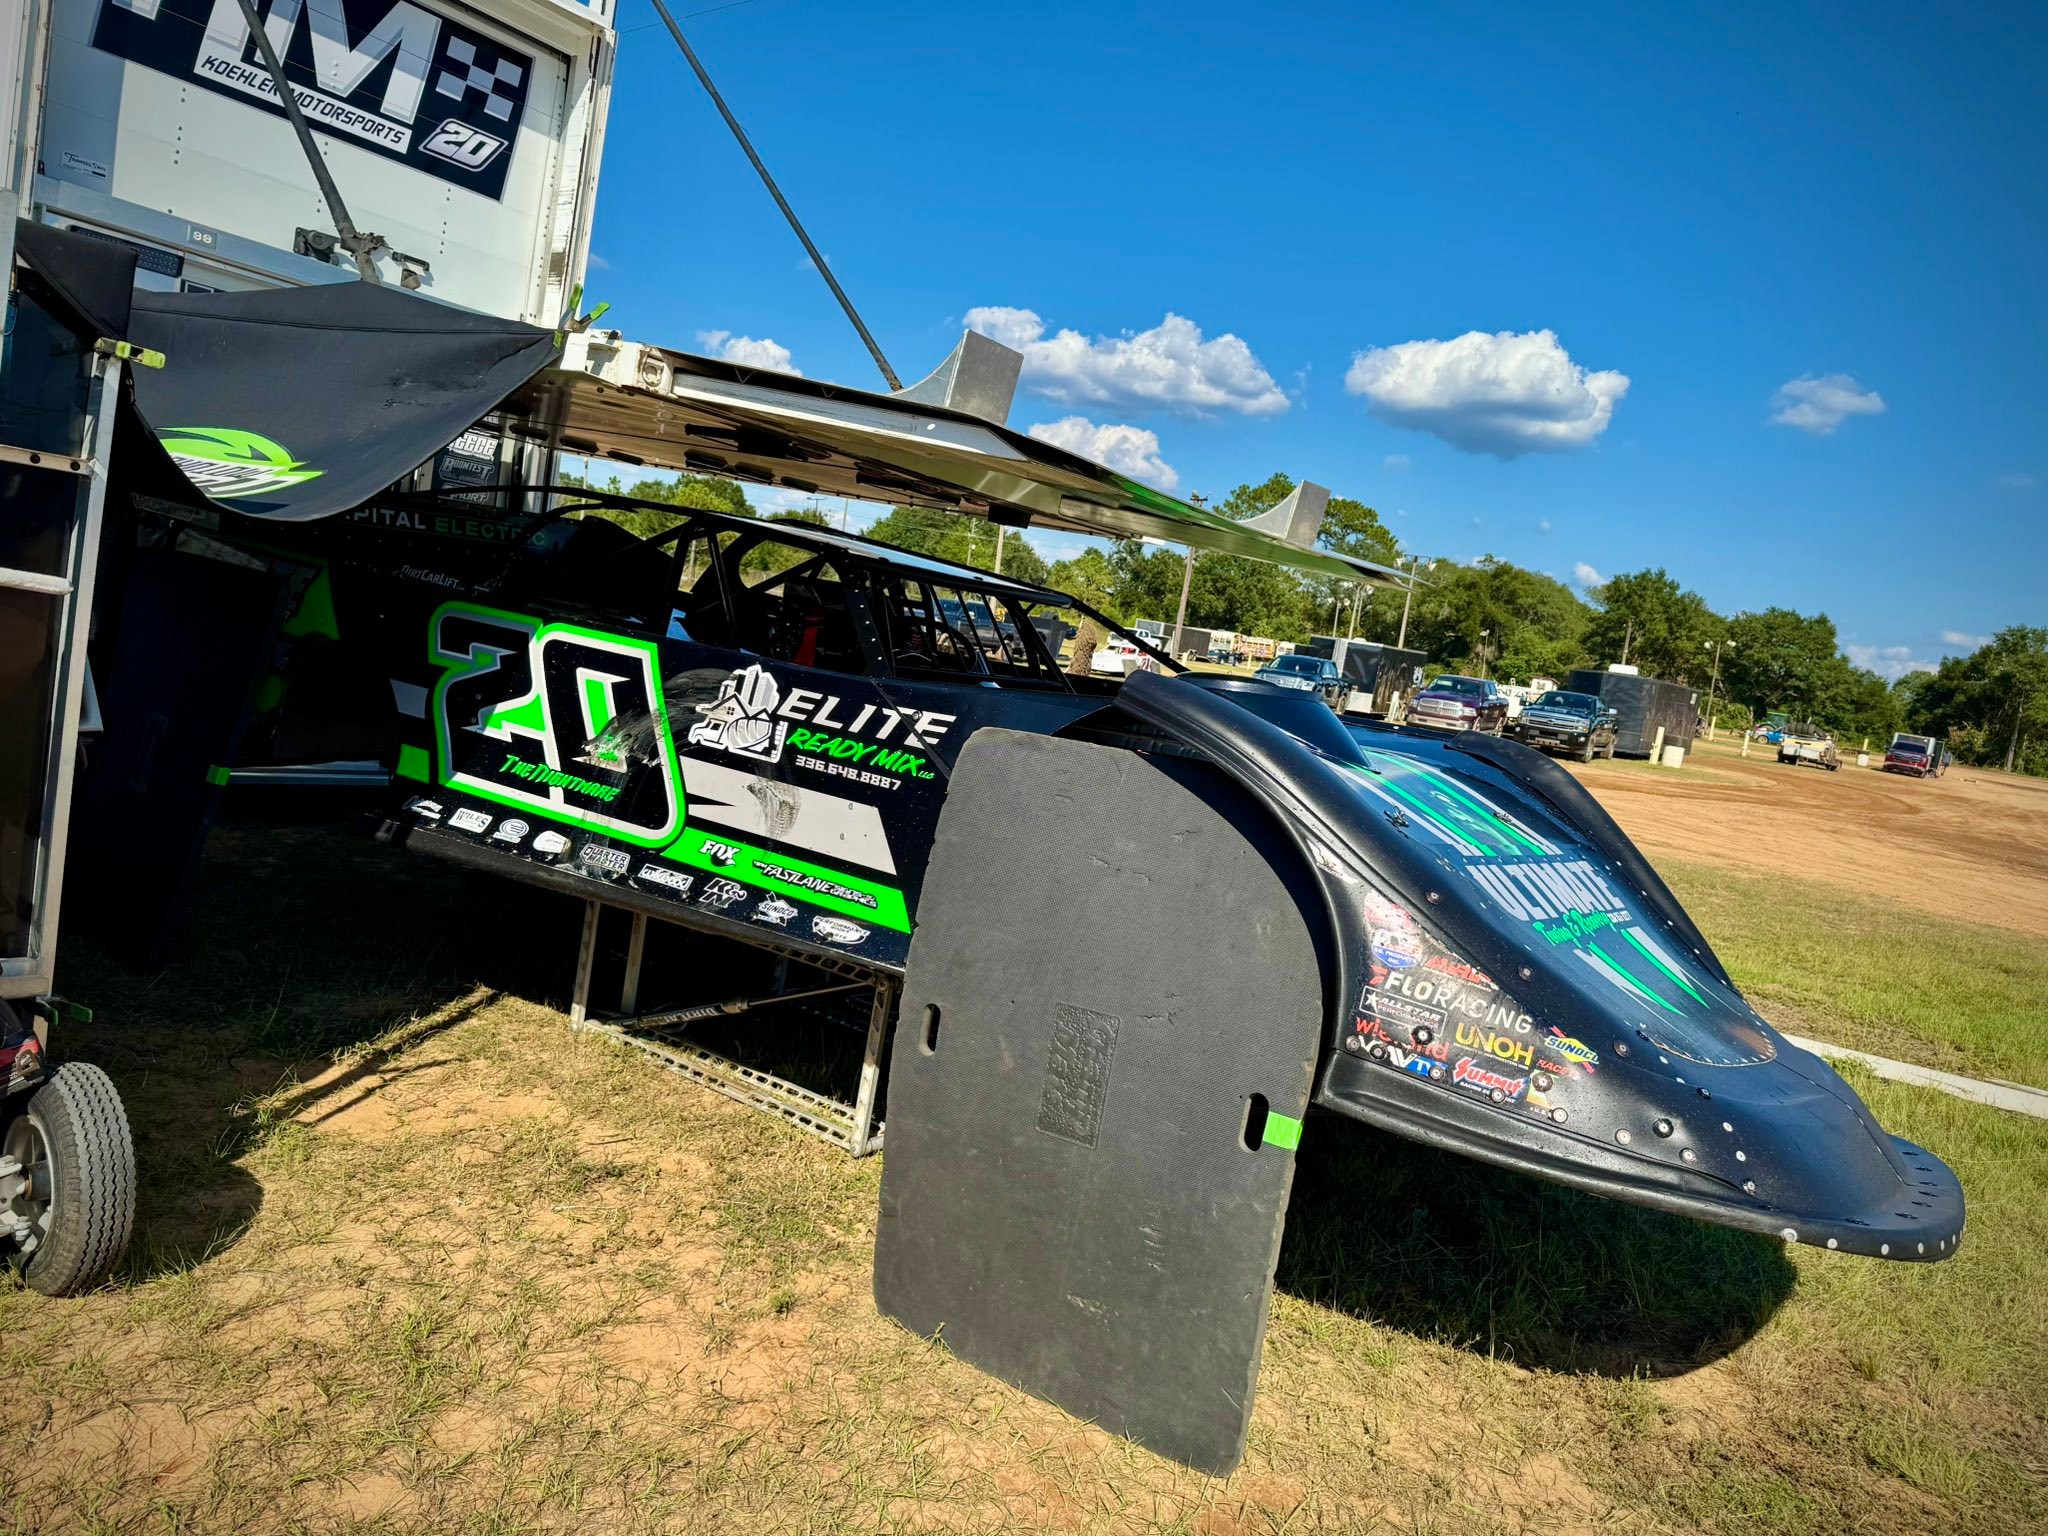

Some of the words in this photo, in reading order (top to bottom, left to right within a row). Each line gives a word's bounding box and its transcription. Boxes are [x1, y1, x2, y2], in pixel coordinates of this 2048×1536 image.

[289, 88, 406, 145] MOTORSPORTS
[424, 121, 502, 167] 20
[428, 601, 686, 849] 20
[776, 687, 957, 750] ELITE
[786, 727, 878, 762] READY
[870, 747, 926, 777] MIX
[795, 754, 902, 791] 336.648.8887
[582, 845, 628, 864] QUARTER
[587, 851, 626, 871] MASTER
[699, 838, 741, 862] FOX
[699, 877, 748, 909] K&N
[762, 863, 834, 893] FASTLANE
[1465, 860, 1626, 922] ULTIMATE
[761, 903, 795, 917] SUNOCO
[1377, 997, 1443, 1022] ALLSTAR
[1384, 971, 1533, 1035] FLORACING
[1455, 1021, 1535, 1067] UNOH
